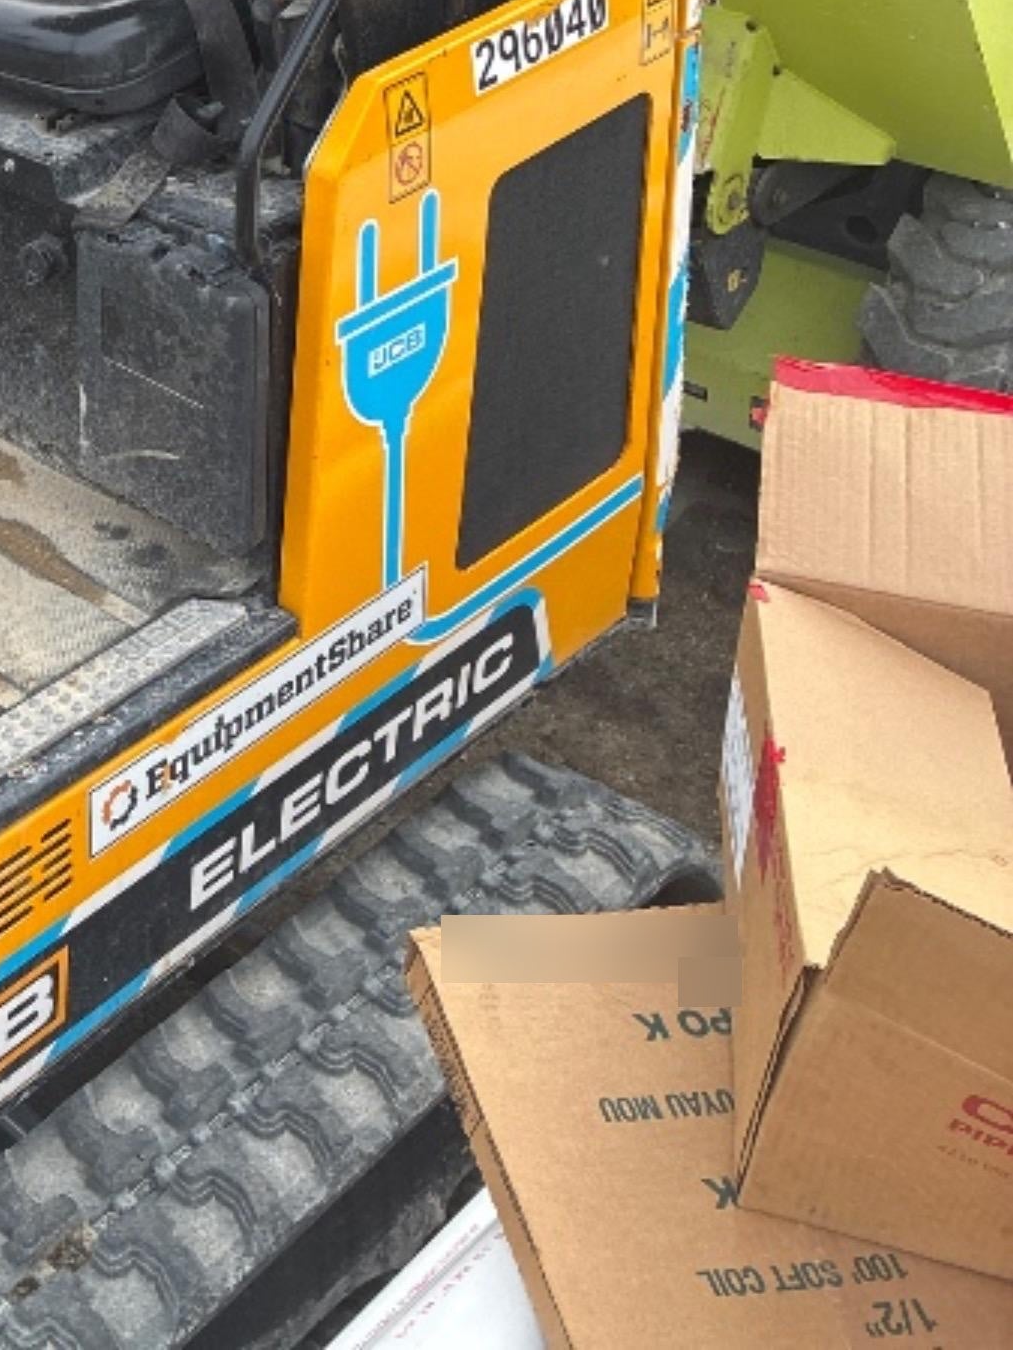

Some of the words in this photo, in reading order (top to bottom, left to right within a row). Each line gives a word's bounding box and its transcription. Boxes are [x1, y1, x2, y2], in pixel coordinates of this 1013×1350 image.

[372, 328, 423, 370] JCB
[144, 594, 415, 801] EquipmentShare
[190, 632, 514, 911] ELECTRIC
[632, 1011, 671, 1041] K
[677, 1007, 732, 1038] PO
[598, 1094, 663, 1123] MOU
[665, 1088, 735, 1120] UYAU
[696, 1266, 766, 1297] COIL
[769, 1259, 843, 1293] SOFT
[852, 1252, 909, 1285] 100'
